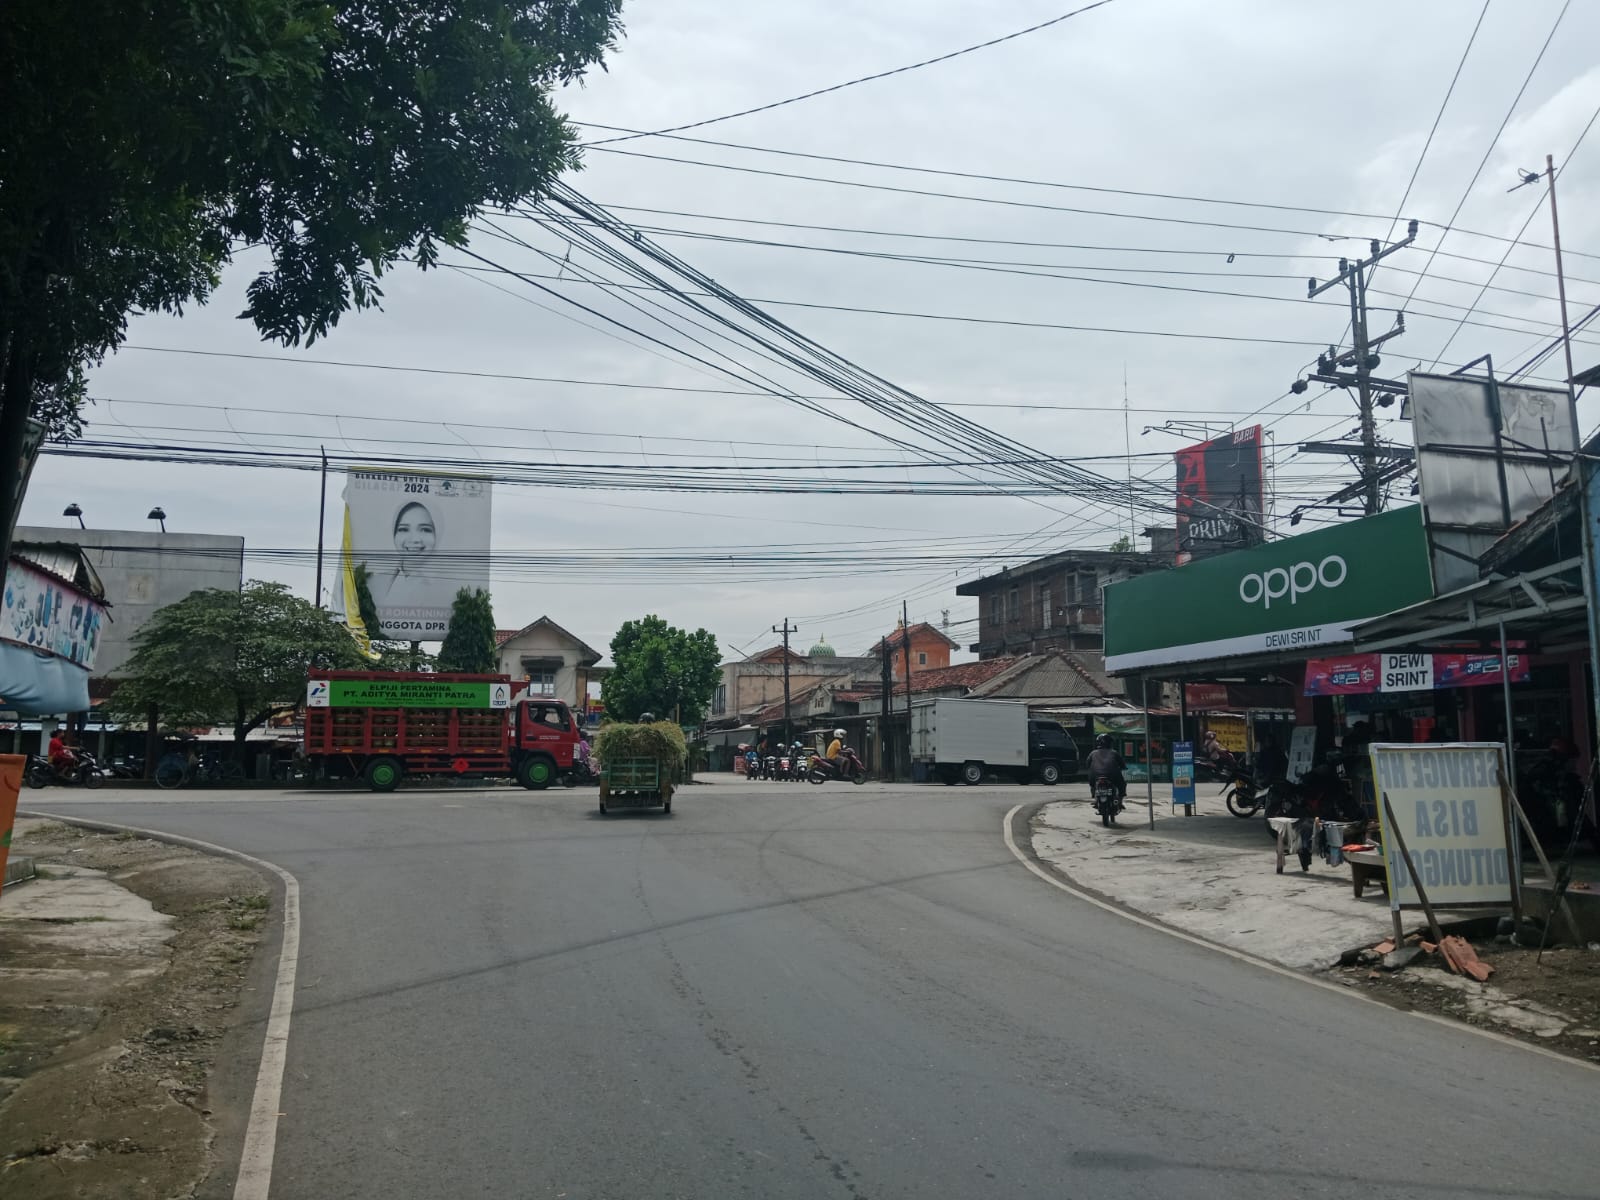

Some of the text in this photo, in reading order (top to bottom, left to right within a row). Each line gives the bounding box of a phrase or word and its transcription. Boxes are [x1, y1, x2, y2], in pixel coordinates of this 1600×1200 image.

[1233, 428, 1255, 444] BARU
[404, 483, 429, 493] 2024
[1240, 555, 1347, 609] oppo
[379, 620, 445, 631] NGGOTA DPR
[1265, 633, 1290, 648] DEWI
[1389, 654, 1425, 669] DEWI
[1386, 670, 1428, 688] SRINT
[343, 690, 358, 698] PT.
[361, 691, 398, 699] ADITYA
[400, 691, 441, 699] MIRANTI
[369, 684, 451, 693] ELPIJI PERTAMINA
